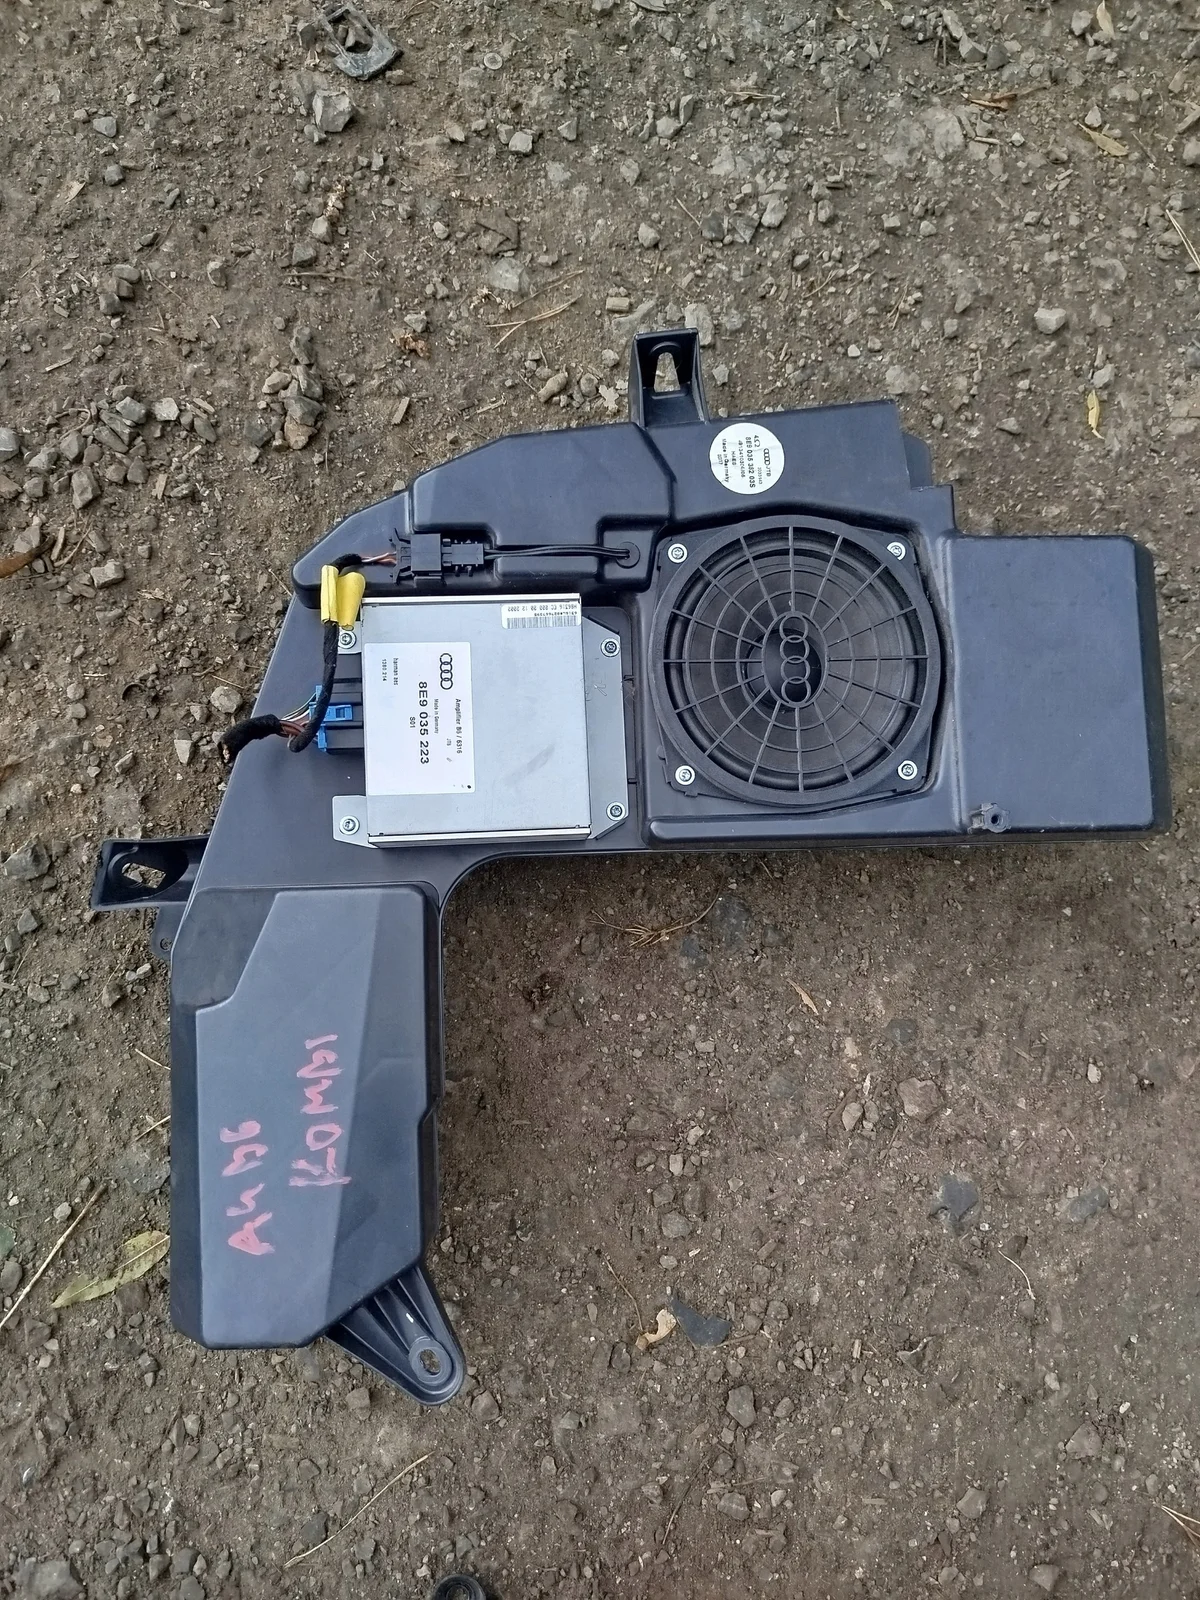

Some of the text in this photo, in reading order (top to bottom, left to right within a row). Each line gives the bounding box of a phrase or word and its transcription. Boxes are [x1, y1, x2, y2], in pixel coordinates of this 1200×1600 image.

[418, 681, 429, 764] 8E9 035 223
